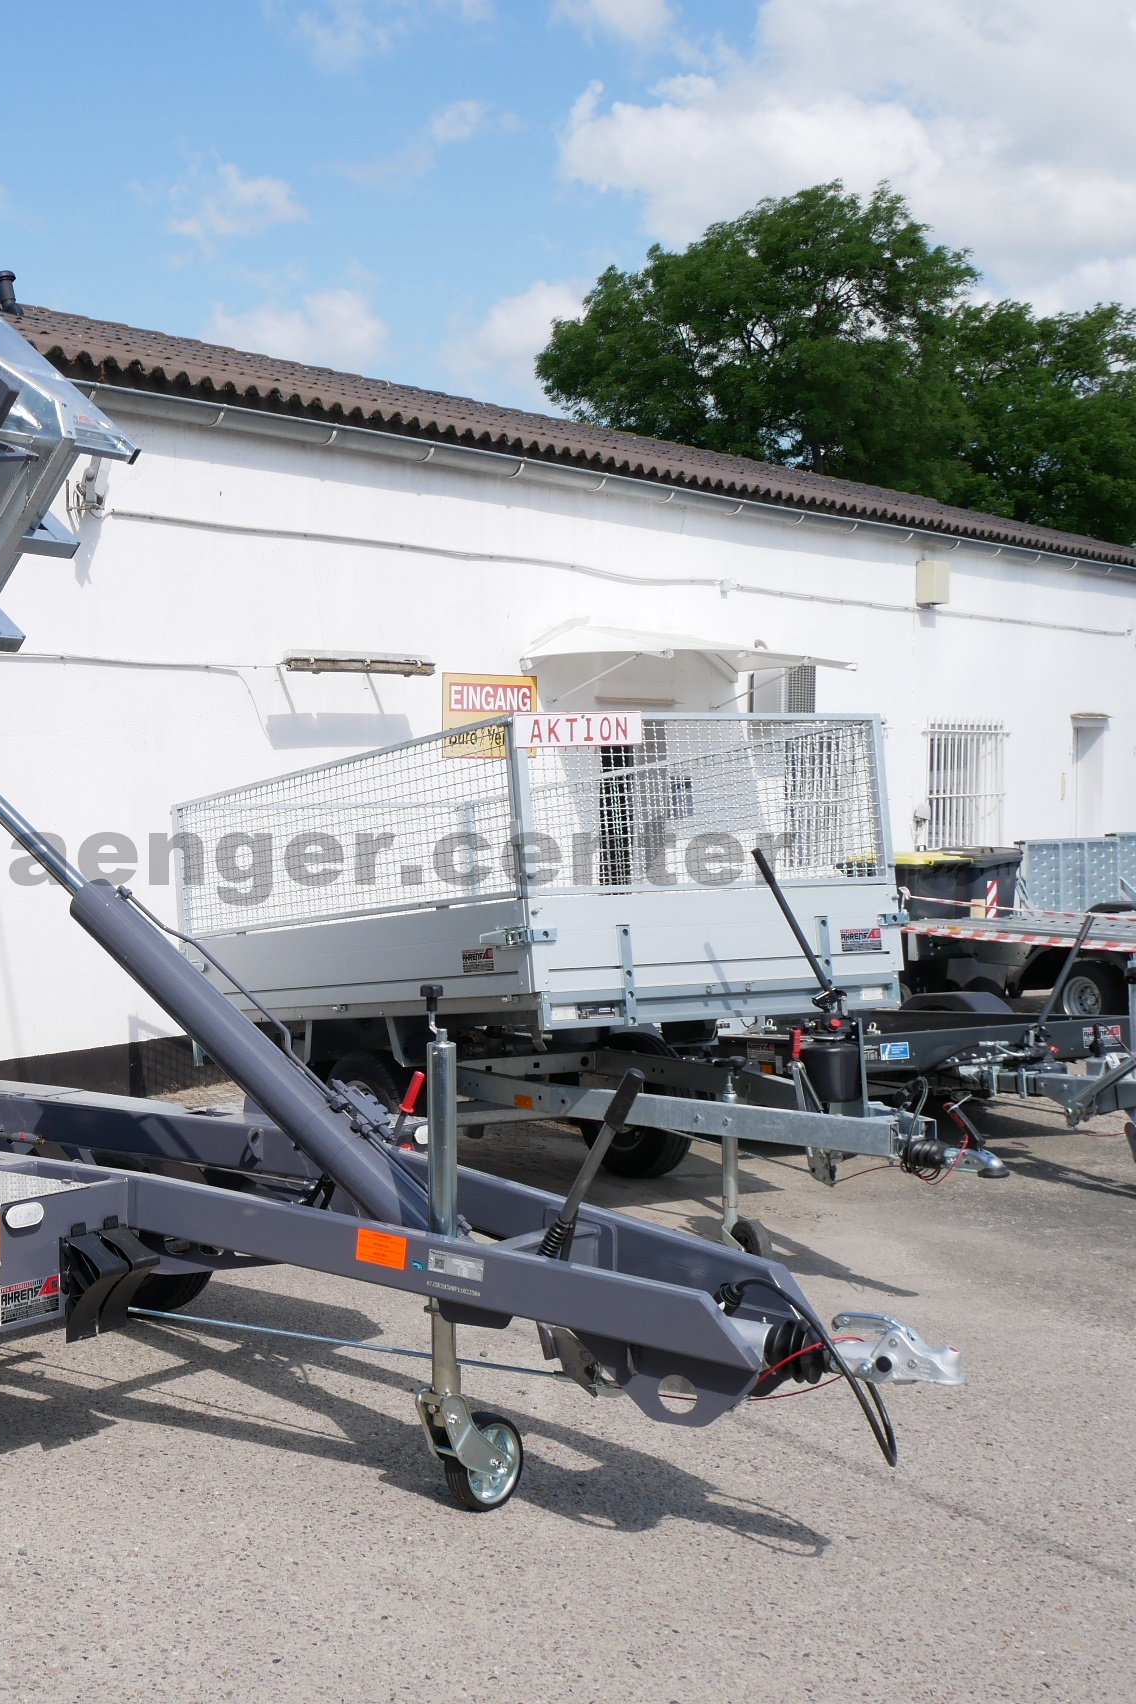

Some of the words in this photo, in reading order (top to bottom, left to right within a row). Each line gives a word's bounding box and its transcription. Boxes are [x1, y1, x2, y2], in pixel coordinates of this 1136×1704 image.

[450, 685, 531, 711] EINGANG
[530, 716, 628, 743] AKTION
[1, 1285, 43, 1306] AHRENS
